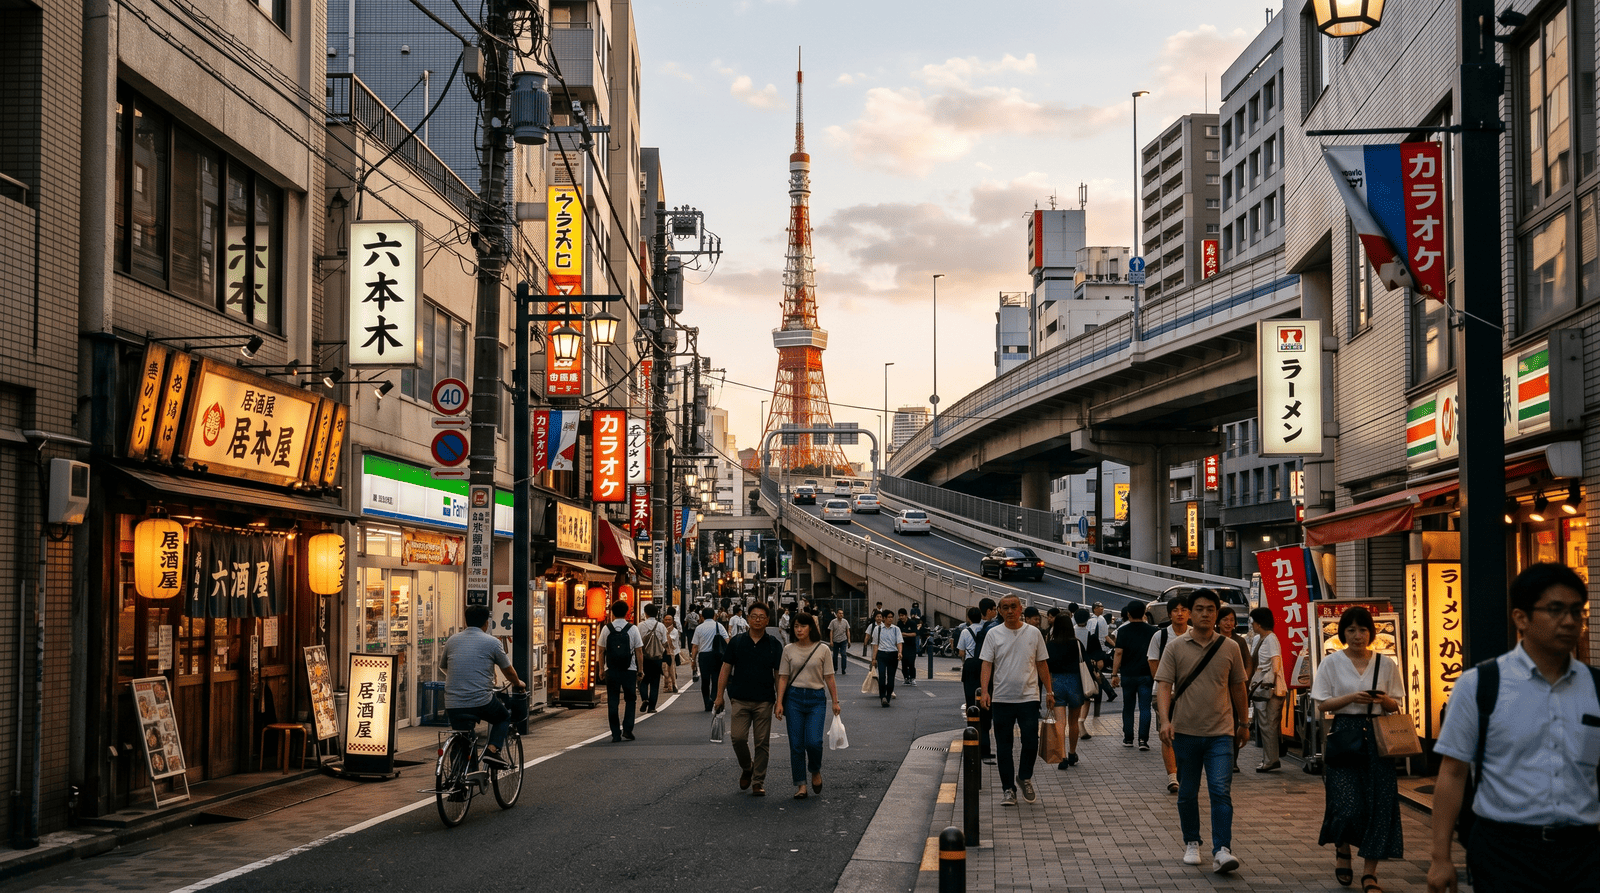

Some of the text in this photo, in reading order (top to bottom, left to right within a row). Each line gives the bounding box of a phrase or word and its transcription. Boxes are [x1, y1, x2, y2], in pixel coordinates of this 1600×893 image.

[1409, 153, 1441, 272] カラオケ
[361, 232, 404, 356] 六本木
[241, 390, 276, 418] 居酒屋
[440, 388, 461, 405] 40
[1281, 359, 1302, 443] ラーメン
[226, 417, 294, 469] 居本屋
[600, 414, 619, 497] カラオケ
[158, 531, 179, 589] 居酒屋
[355, 682, 375, 739] 居酒屋
[376, 671, 388, 704] 居酒屋
